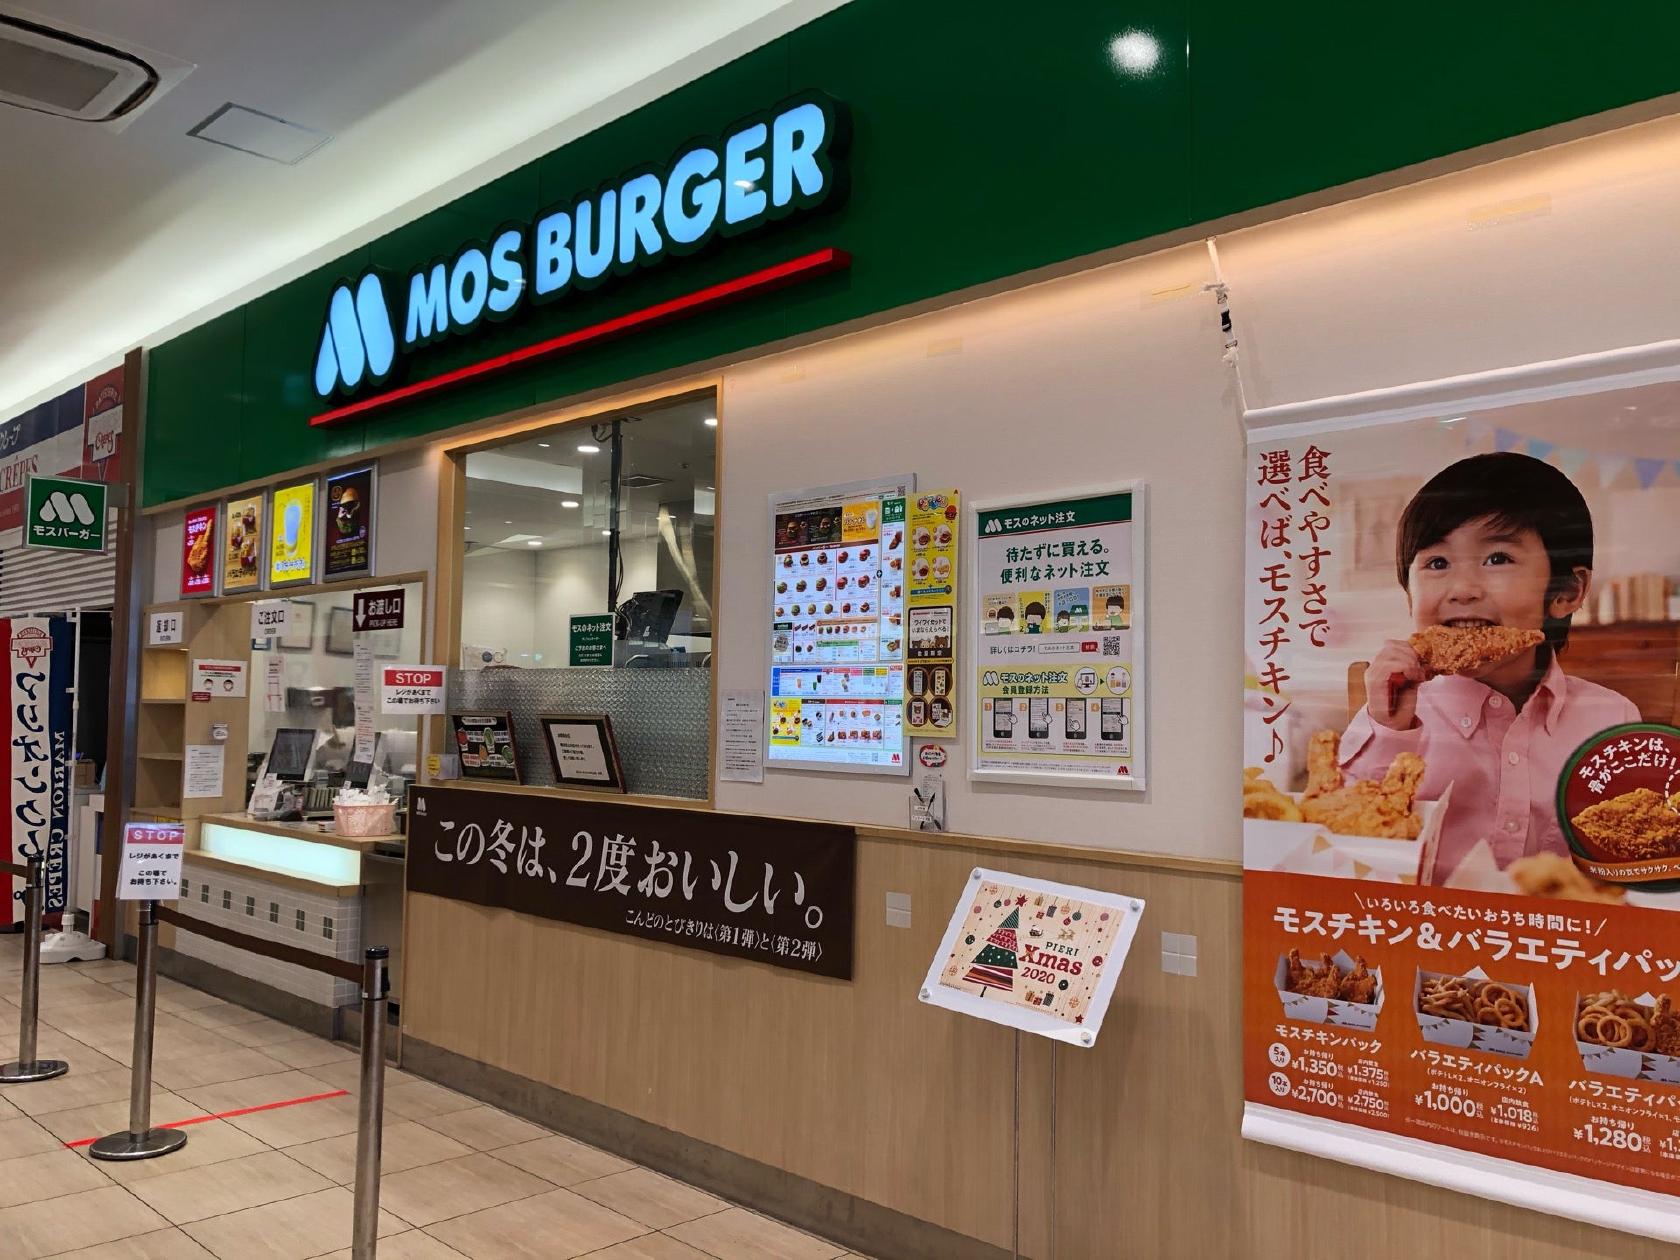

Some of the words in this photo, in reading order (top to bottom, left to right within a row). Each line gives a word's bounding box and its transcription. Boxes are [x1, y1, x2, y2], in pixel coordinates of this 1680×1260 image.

[405, 230, 523, 343] MOS
[535, 103, 826, 295] BURGER
[1004, 510, 1076, 529] モスのネット注文
[33, 525, 101, 540] モスバーガー
[1006, 539, 1109, 563] 待たずに買える。
[1298, 445, 1332, 648] 食べやすさで
[1001, 560, 1110, 584] 便利なネット注文
[572, 622, 612, 632] モスのネット注文
[990, 645, 1036, 655] 詳しくはコチラ!
[396, 673, 432, 684] STOP
[1000, 671, 1068, 684] モスのネット注文
[1002, 685, 1049, 695] 会員登録方法
[1579, 738, 1670, 779] モスチキンは、
[1588, 752, 1677, 795] 骨がここだけ!
[134, 830, 178, 840] STOP
[434, 819, 824, 929] この冬は、2度おいしい。
[1045, 941, 1080, 957] PIERI
[1018, 944, 1083, 976] Xmas
[1021, 967, 1056, 985] 2020
[1303, 1048, 1334, 1061] お持ち帰り
[1292, 1057, 1338, 1077] ¥1,350
[1348, 1064, 1385, 1080] ¥1,375
[1410, 1050, 1544, 1087] バラエティパックA
[1303, 1078, 1334, 1090] お持ち帰り
[1431, 1082, 1469, 1097] お持ち帰り
[1291, 1086, 1338, 1107] ¥2,700
[1348, 1094, 1385, 1110] ¥2,750
[1568, 1080, 1680, 1107] バラエティパ
[1415, 1090, 1476, 1118] ¥1,000
[1490, 1104, 1533, 1123] ¥1,018
[1591, 1115, 1635, 1131] お持ち帰り
[1573, 1124, 1643, 1152] ¥1,280
[1659, 1137, 1680, 1153] ¥1,
